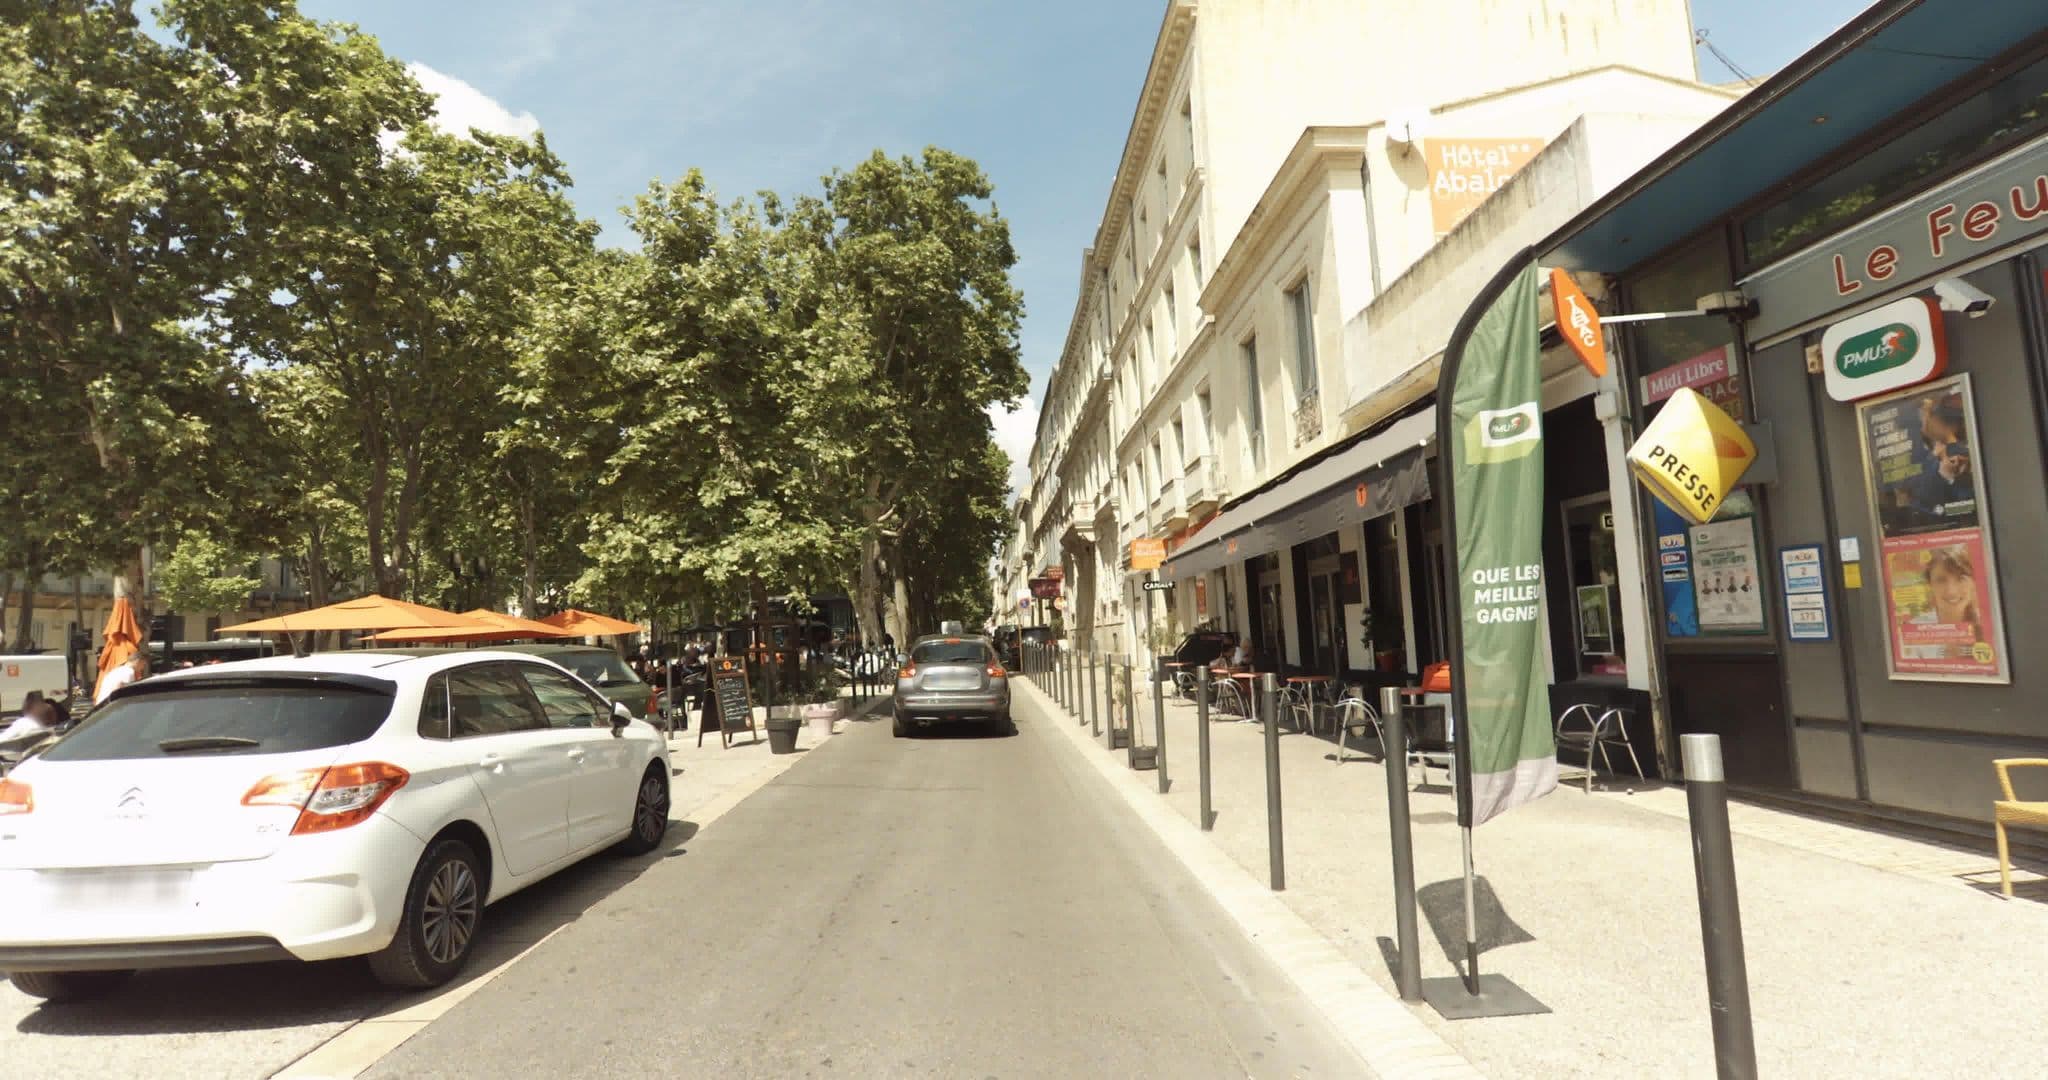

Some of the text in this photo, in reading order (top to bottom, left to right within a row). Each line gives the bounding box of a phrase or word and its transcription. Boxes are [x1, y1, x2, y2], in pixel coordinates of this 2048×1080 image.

[1833, 245, 1898, 296] Le
[1565, 295, 1596, 347] TABAC
[1651, 359, 1724, 395] Midi Libre
[1843, 344, 1881, 369] PMU
[1648, 445, 1715, 512] PRESSE
[1472, 564, 1540, 585] QUE LES
